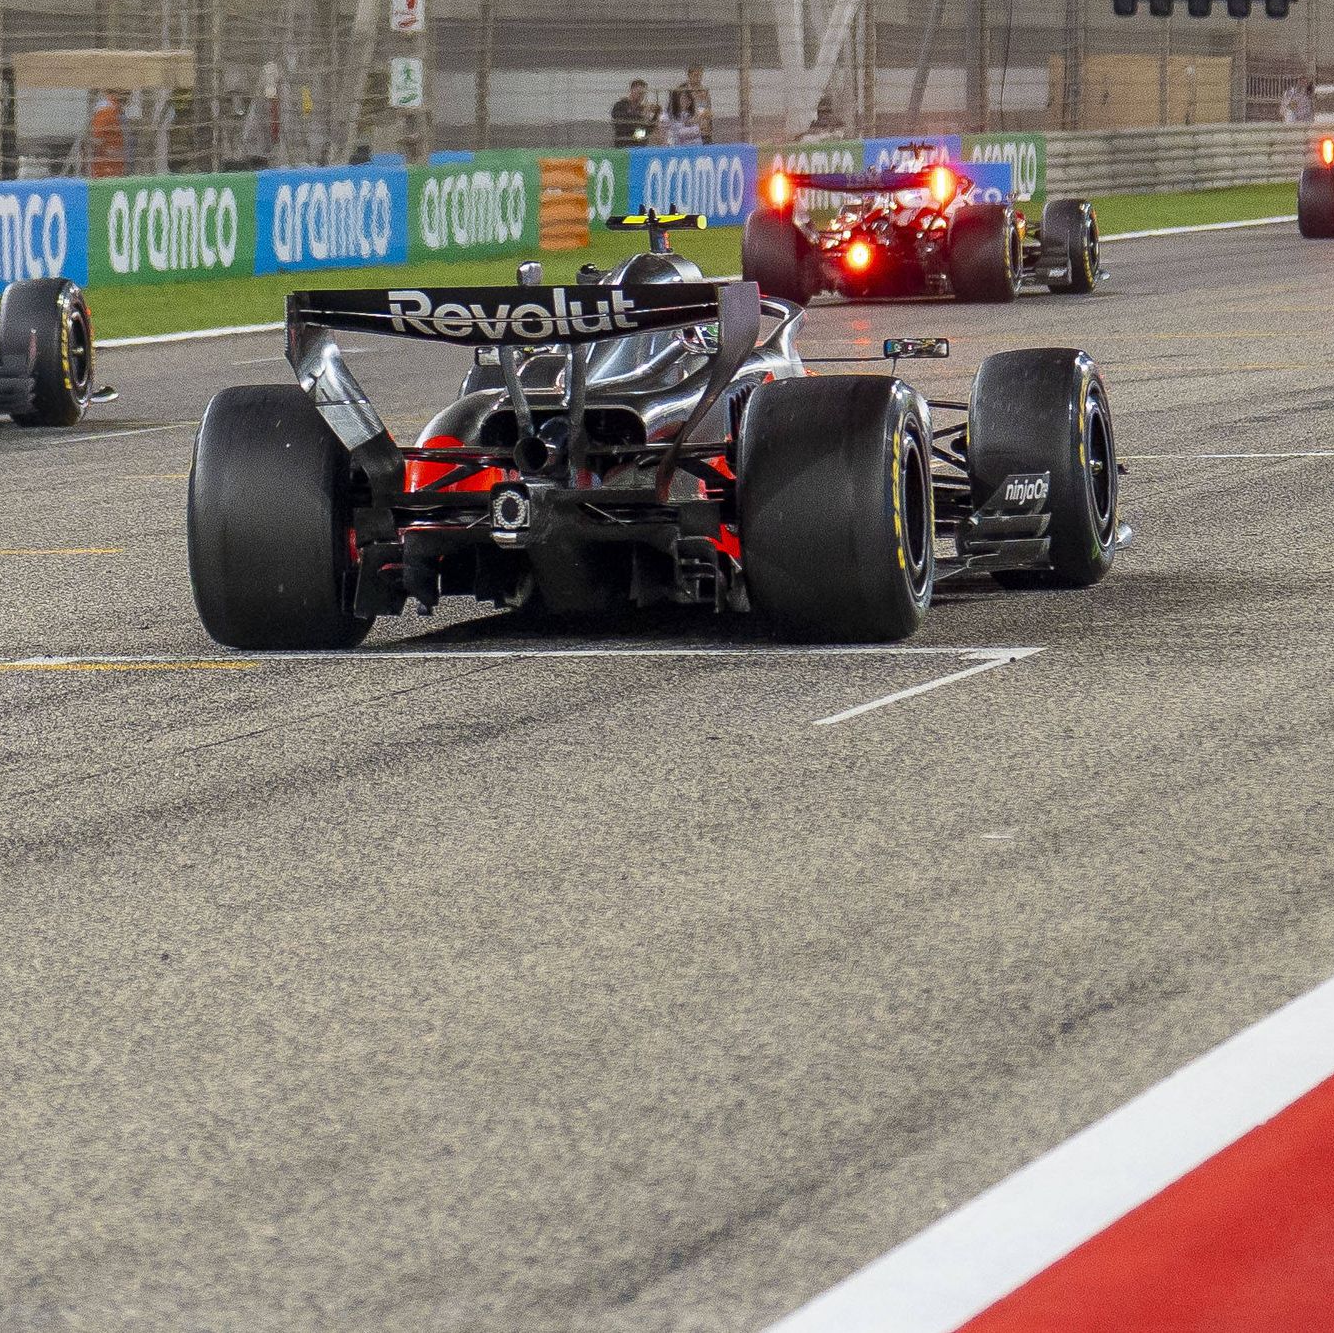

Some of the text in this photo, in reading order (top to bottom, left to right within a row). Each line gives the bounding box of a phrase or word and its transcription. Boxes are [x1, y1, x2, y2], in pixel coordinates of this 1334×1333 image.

[273, 179, 391, 263] aramco
[419, 170, 526, 249] aramco
[644, 155, 744, 219] aramco
[107, 187, 238, 273] aramco
[387, 287, 639, 339] Revolut
